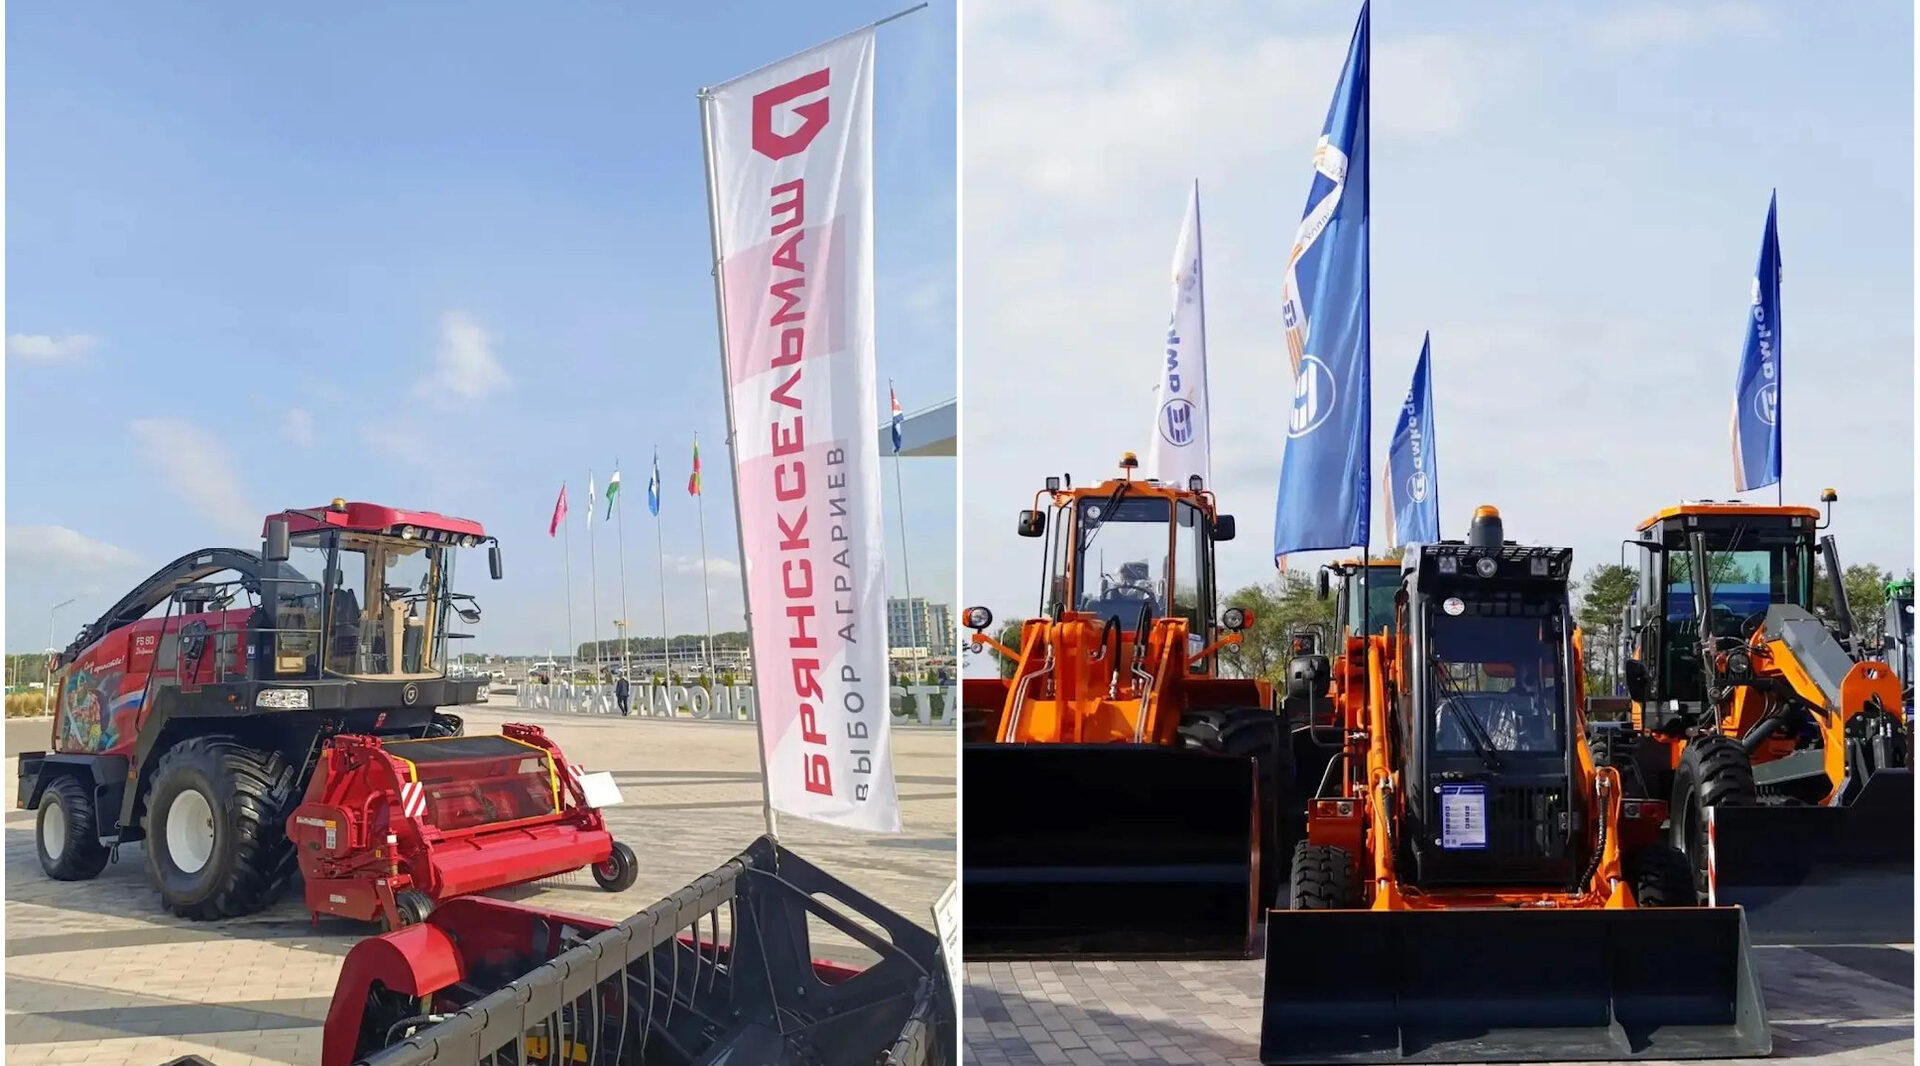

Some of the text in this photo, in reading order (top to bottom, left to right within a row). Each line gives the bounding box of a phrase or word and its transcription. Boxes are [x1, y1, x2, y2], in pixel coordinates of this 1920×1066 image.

[770, 178, 833, 797] БРЯНСКСЕЛЬМАШ
[827, 446, 873, 801] ВЫБОР АГРАРИЕВ
